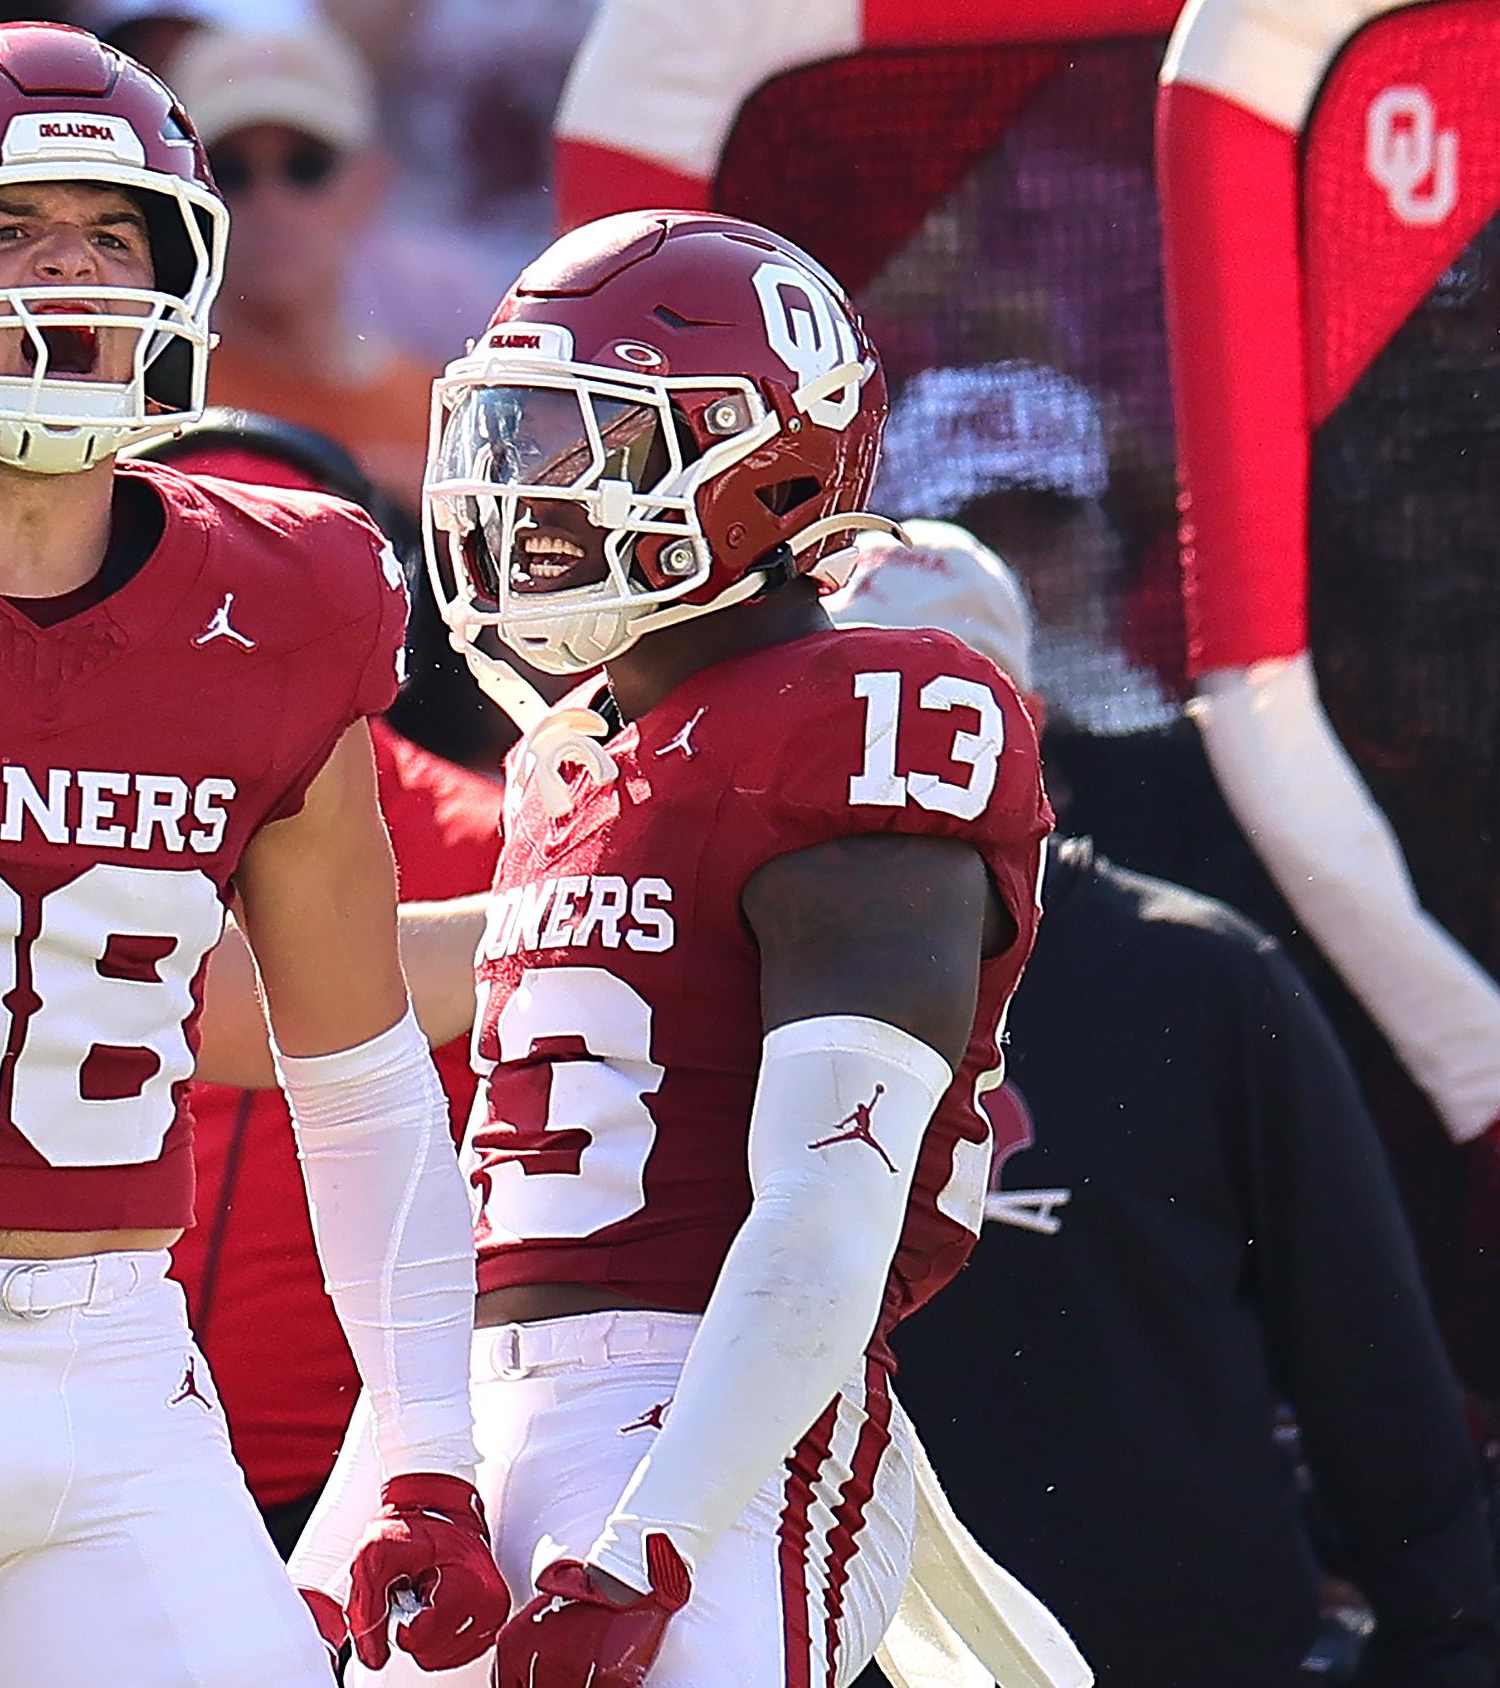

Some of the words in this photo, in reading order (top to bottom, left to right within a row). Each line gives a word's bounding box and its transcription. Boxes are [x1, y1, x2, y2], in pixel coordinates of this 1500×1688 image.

[39, 123, 115, 141] OKLAHOMA
[1366, 86, 1460, 225] OU
[752, 262, 876, 431] OU
[849, 671, 1005, 821] 13
[475, 874, 676, 967] ONERS
